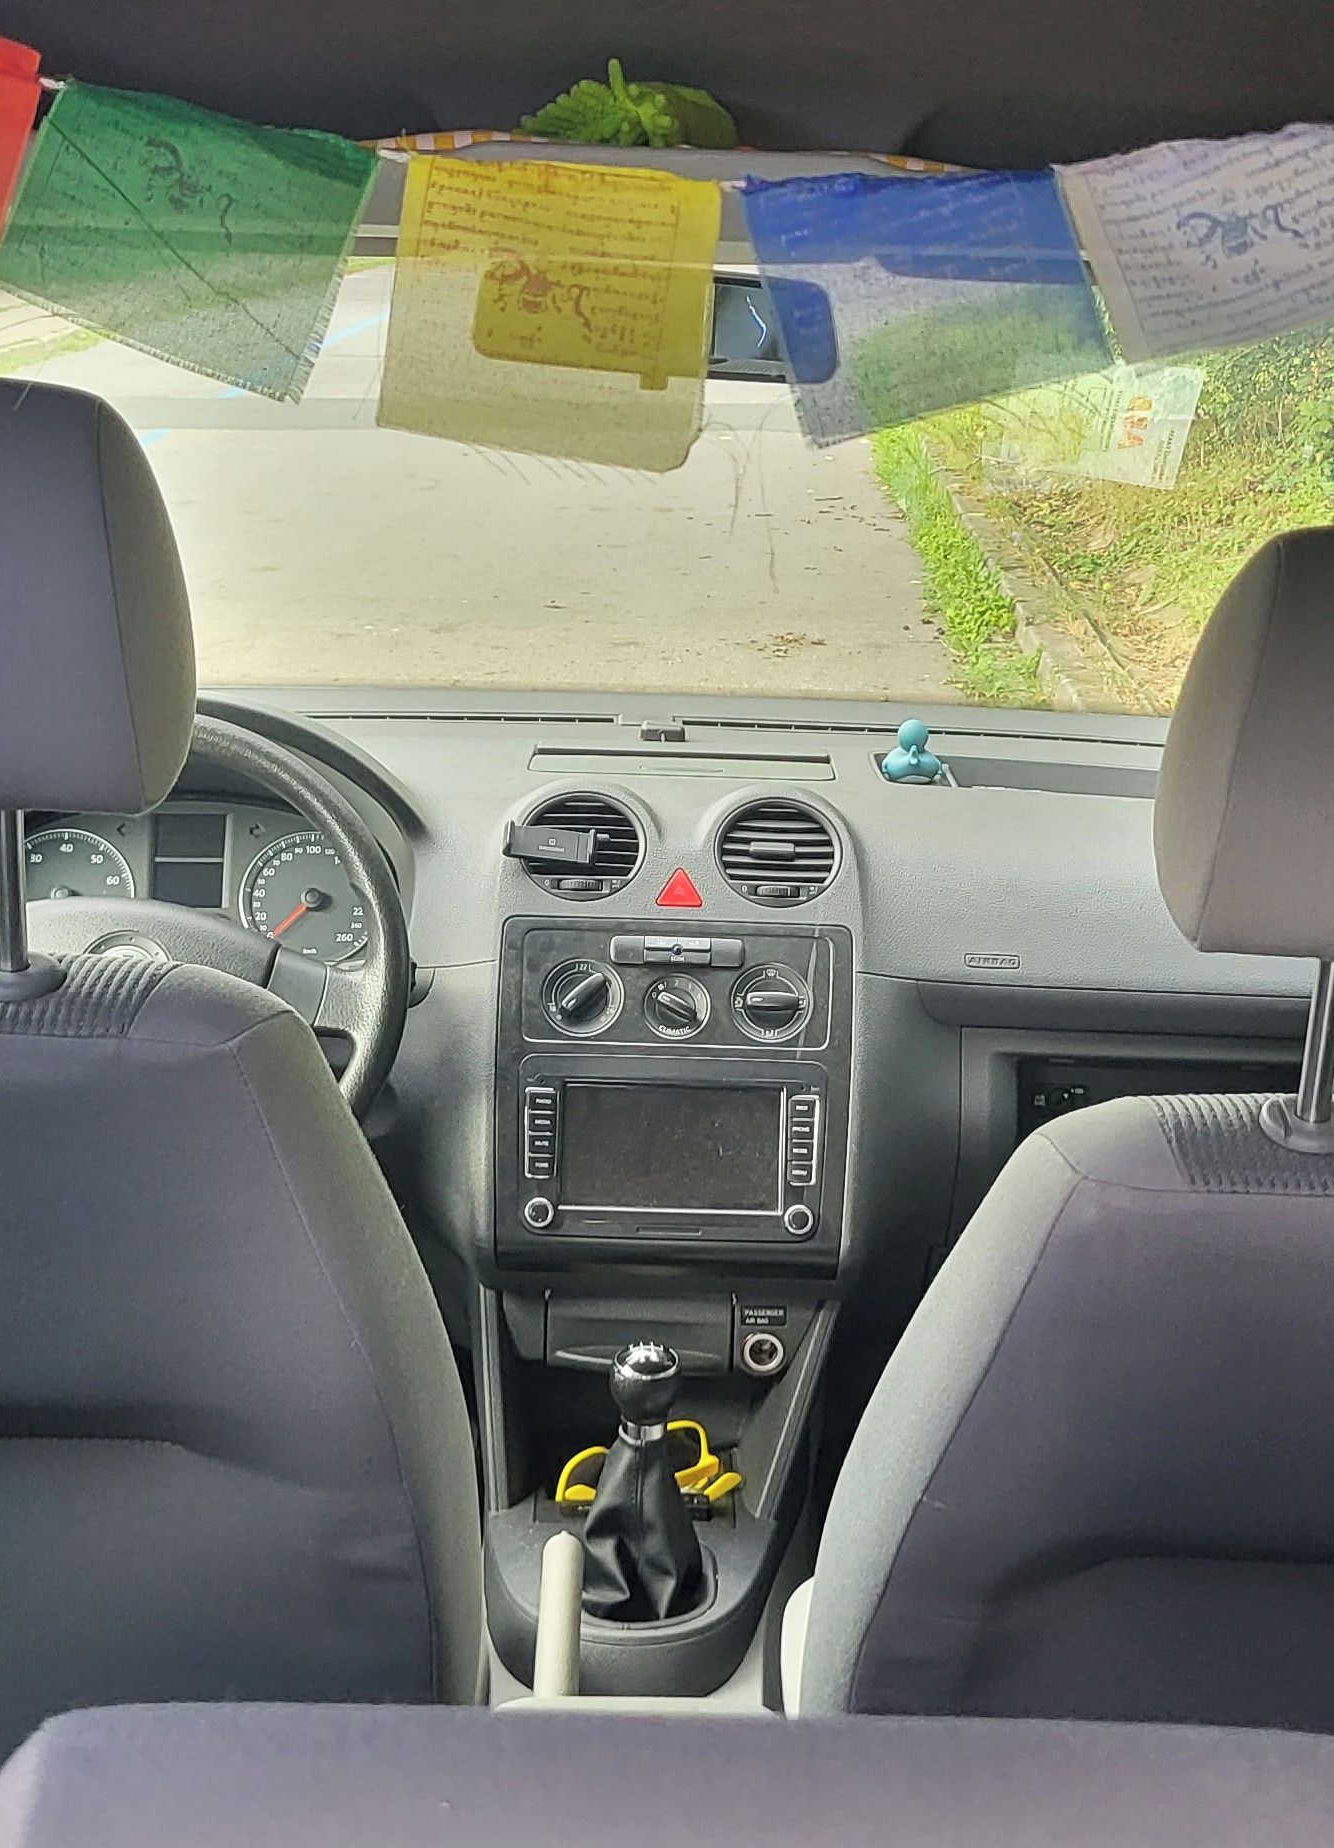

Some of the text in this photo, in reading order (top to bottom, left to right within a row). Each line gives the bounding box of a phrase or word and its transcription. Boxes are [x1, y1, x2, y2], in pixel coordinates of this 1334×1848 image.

[59, 843, 74, 853] 40
[306, 845, 322, 854] 100
[29, 853, 43, 863] 30
[90, 854, 104, 864] 50
[280, 853, 293, 862] 80
[262, 868, 275, 876] 60
[106, 875, 120, 885] 60
[253, 888, 266, 898] 40
[255, 912, 266, 921] 20
[335, 933, 354, 942] 260
[968, 956, 1017, 966] AIRBAG
[579, 963, 588, 971] 22
[658, 1024, 692, 1036] CLIMATIC
[744, 1308, 784, 1316] PASSENGER
